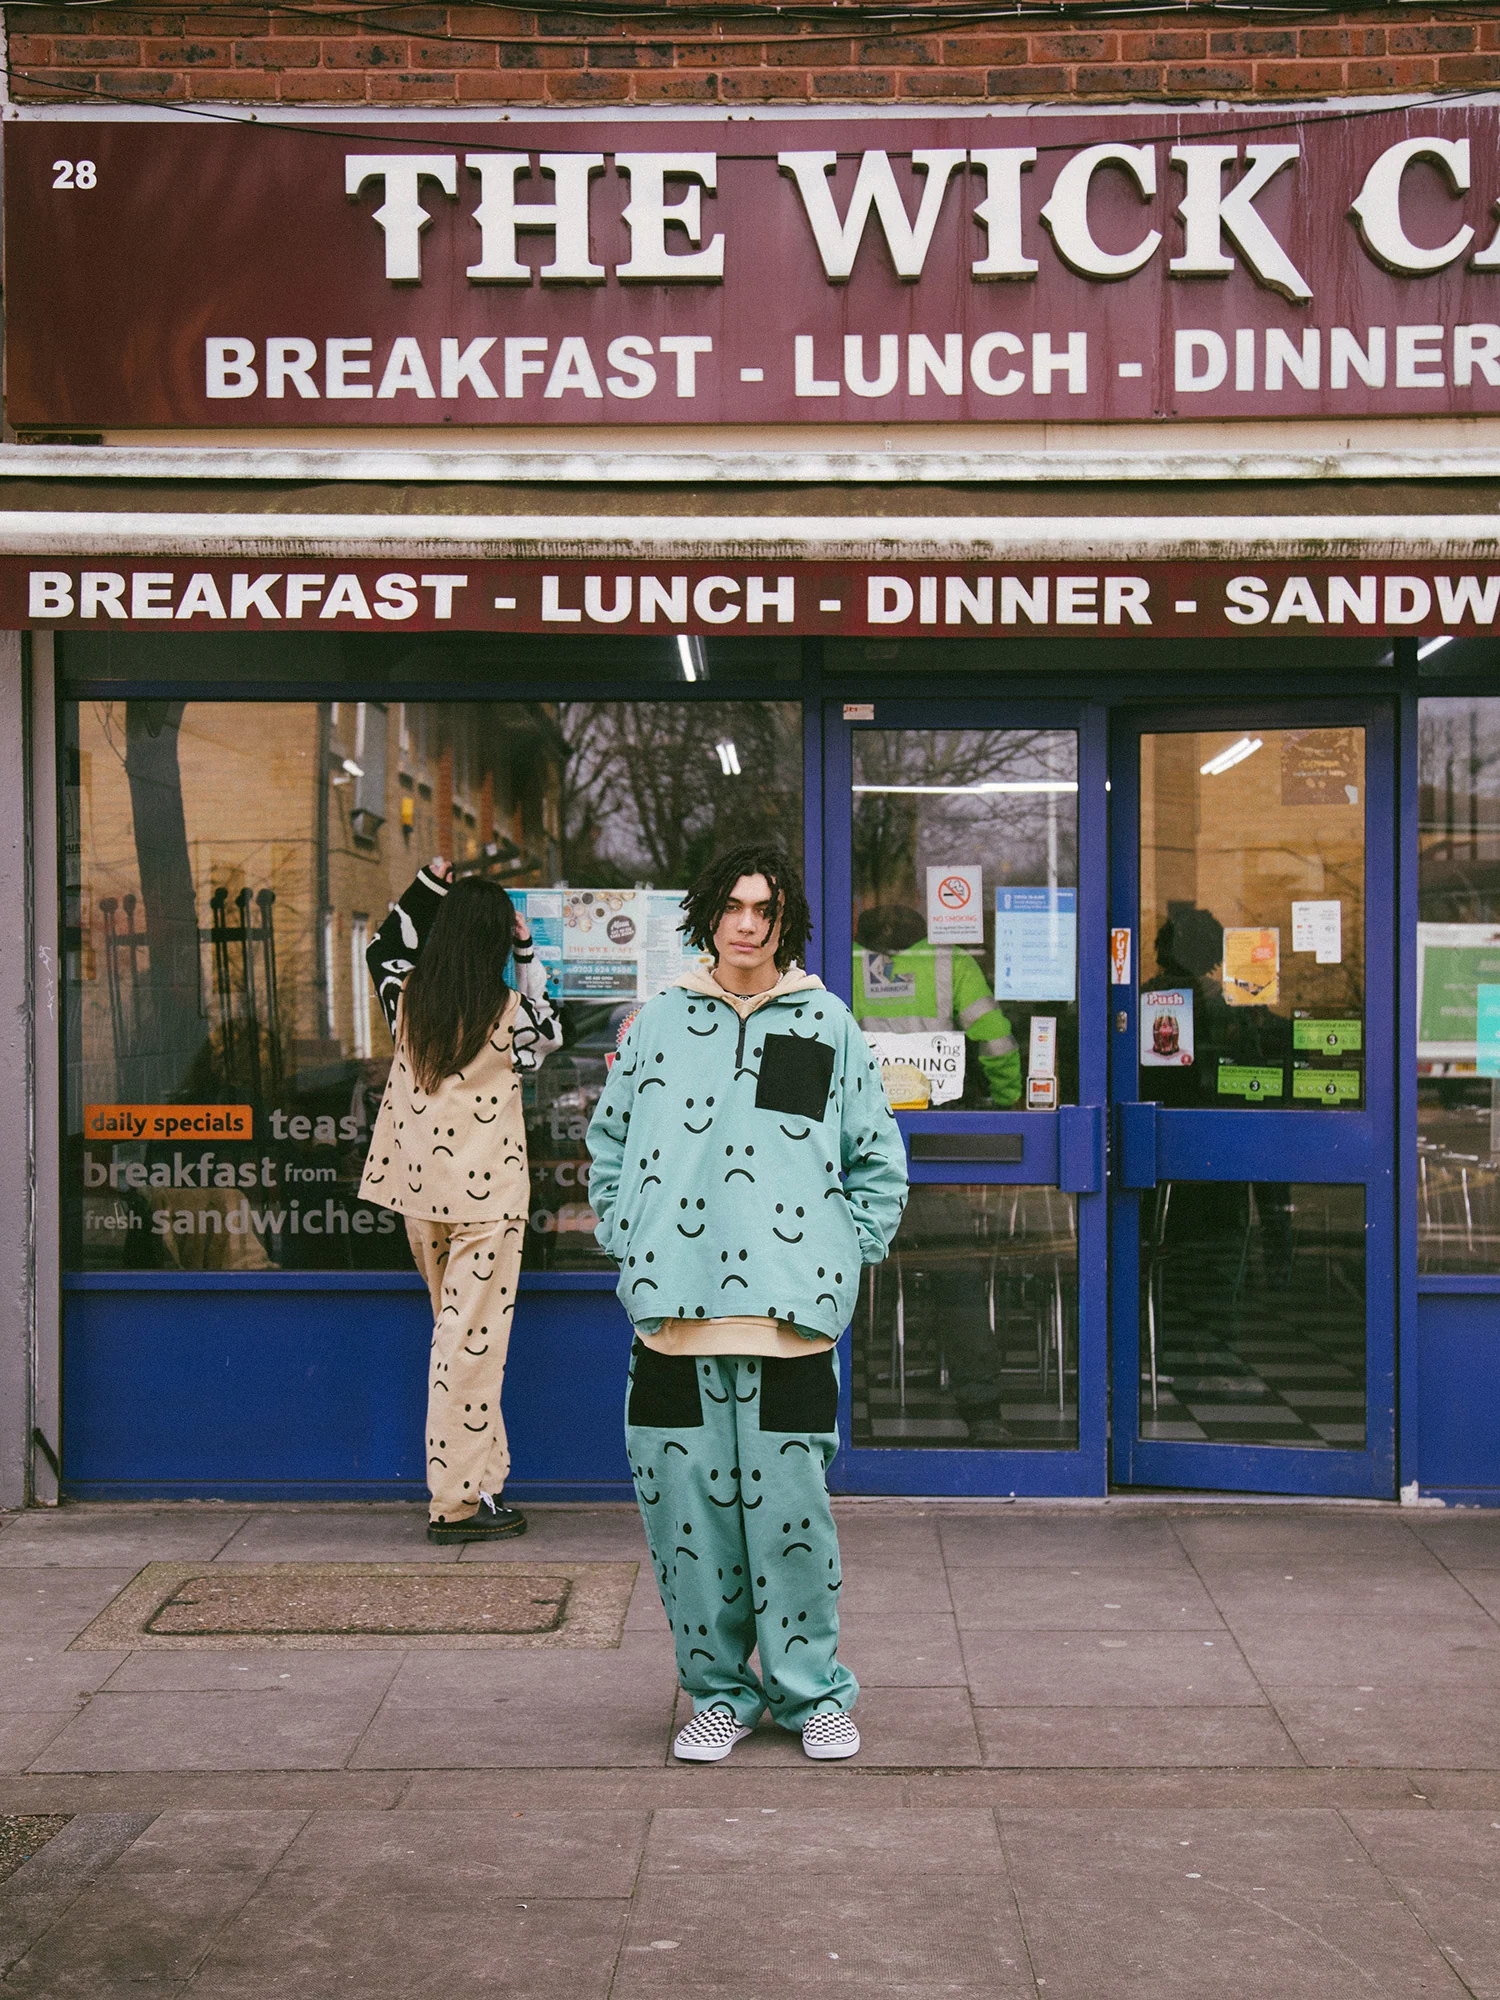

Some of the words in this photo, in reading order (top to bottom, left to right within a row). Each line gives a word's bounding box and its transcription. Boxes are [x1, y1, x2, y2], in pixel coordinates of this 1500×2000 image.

[52, 160, 97, 190] 28
[345, 152, 726, 283] THE
[777, 143, 1314, 302] WICK
[1350, 136, 1500, 272] C
[206, 335, 713, 400] BREAKFAST
[794, 331, 1088, 398] LUNCH
[1174, 323, 1500, 392] DINNER
[28, 571, 468, 620] BREAKFAST
[541, 575, 795, 624] LUNCH
[867, 576, 1153, 625] DINNER
[1224, 576, 1500, 625] SANDW
[1147, 993, 1185, 1006] Push
[1328, 1034, 1336, 1046] 3
[876, 1057, 957, 1073] ANING
[1250, 1080, 1258, 1092] 3
[1326, 1083, 1335, 1096] 3
[90, 1112, 147, 1137] daily
[153, 1112, 244, 1137] specials
[269, 1108, 359, 1141] teas
[550, 1108, 588, 1141] ta
[83, 1151, 278, 1188] breakfast
[284, 1162, 337, 1183] from
[554, 1161, 592, 1187] co
[84, 1210, 143, 1230] fresh
[151, 1198, 396, 1235] sandwiches
